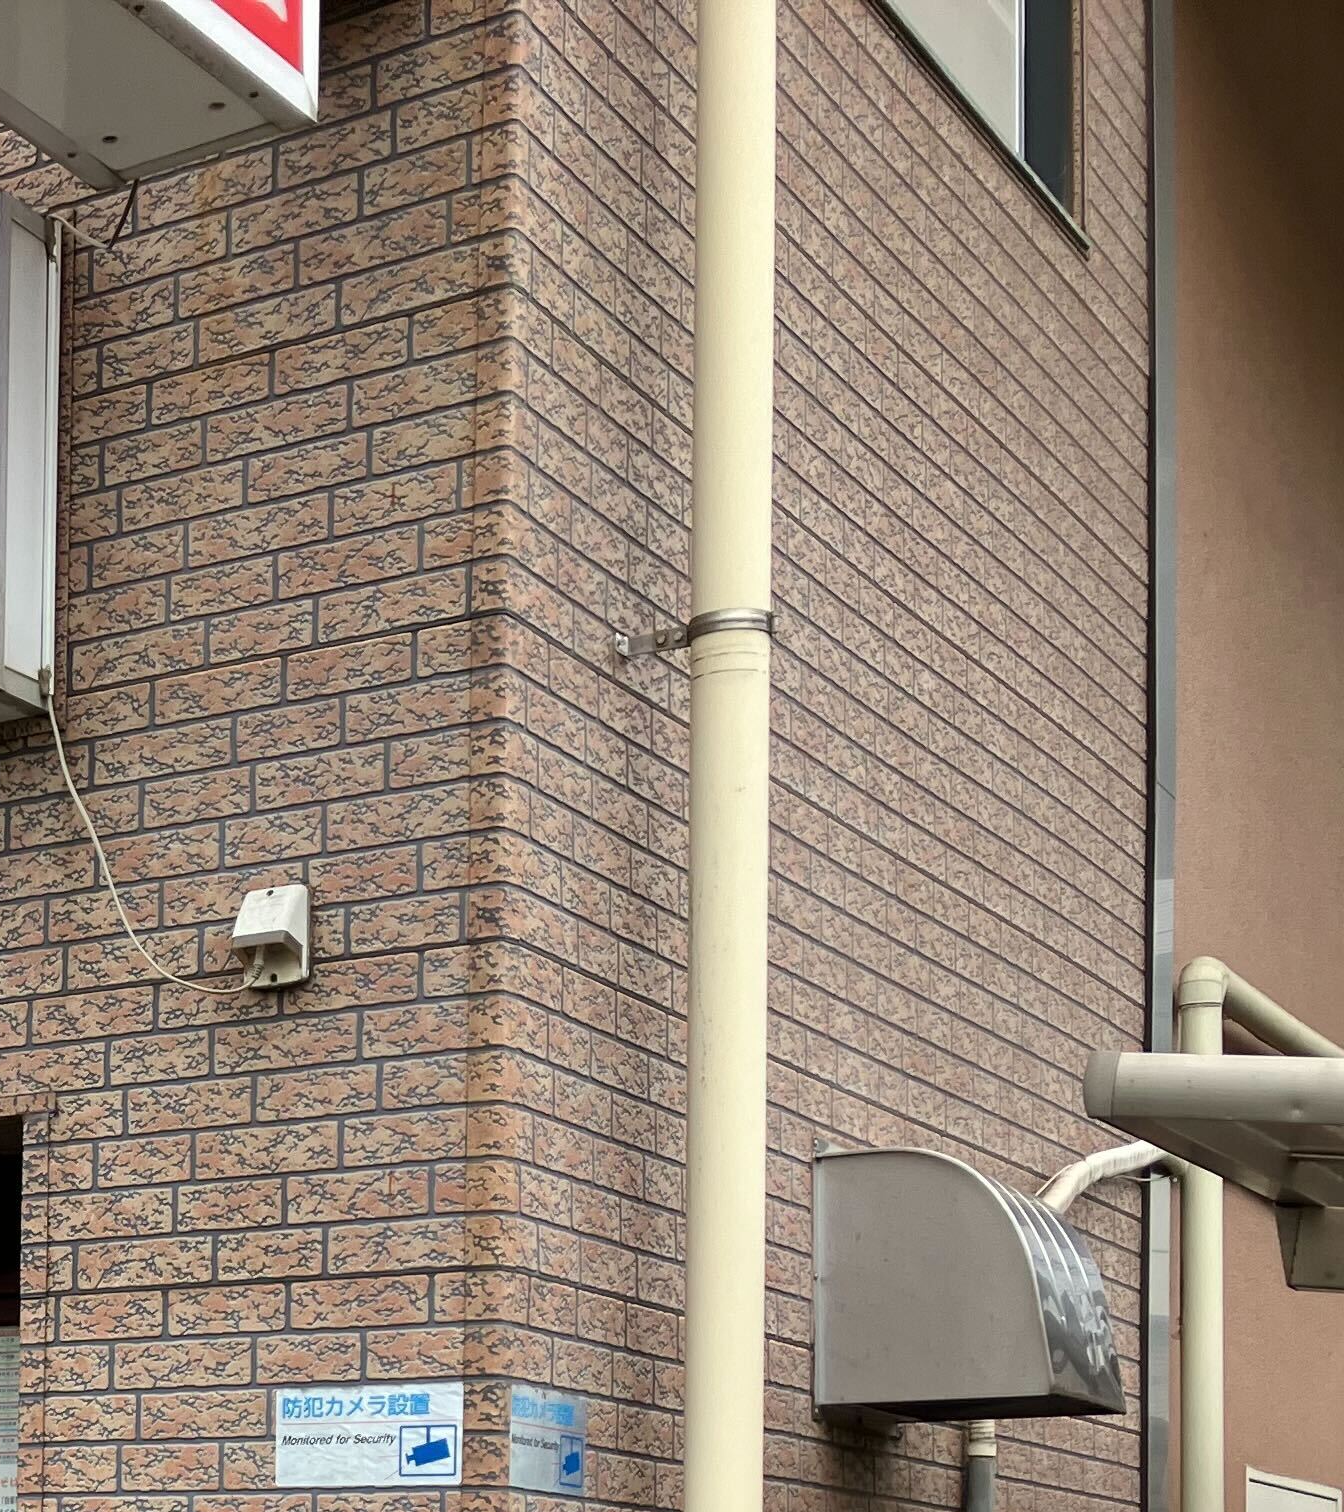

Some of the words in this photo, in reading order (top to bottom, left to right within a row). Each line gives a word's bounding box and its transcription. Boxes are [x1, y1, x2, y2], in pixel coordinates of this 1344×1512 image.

[281, 1392, 431, 1420] 防犯カメラ設置
[281, 1434, 334, 1447] Monitored
[335, 1433, 349, 1446] for
[353, 1432, 397, 1447] Security
